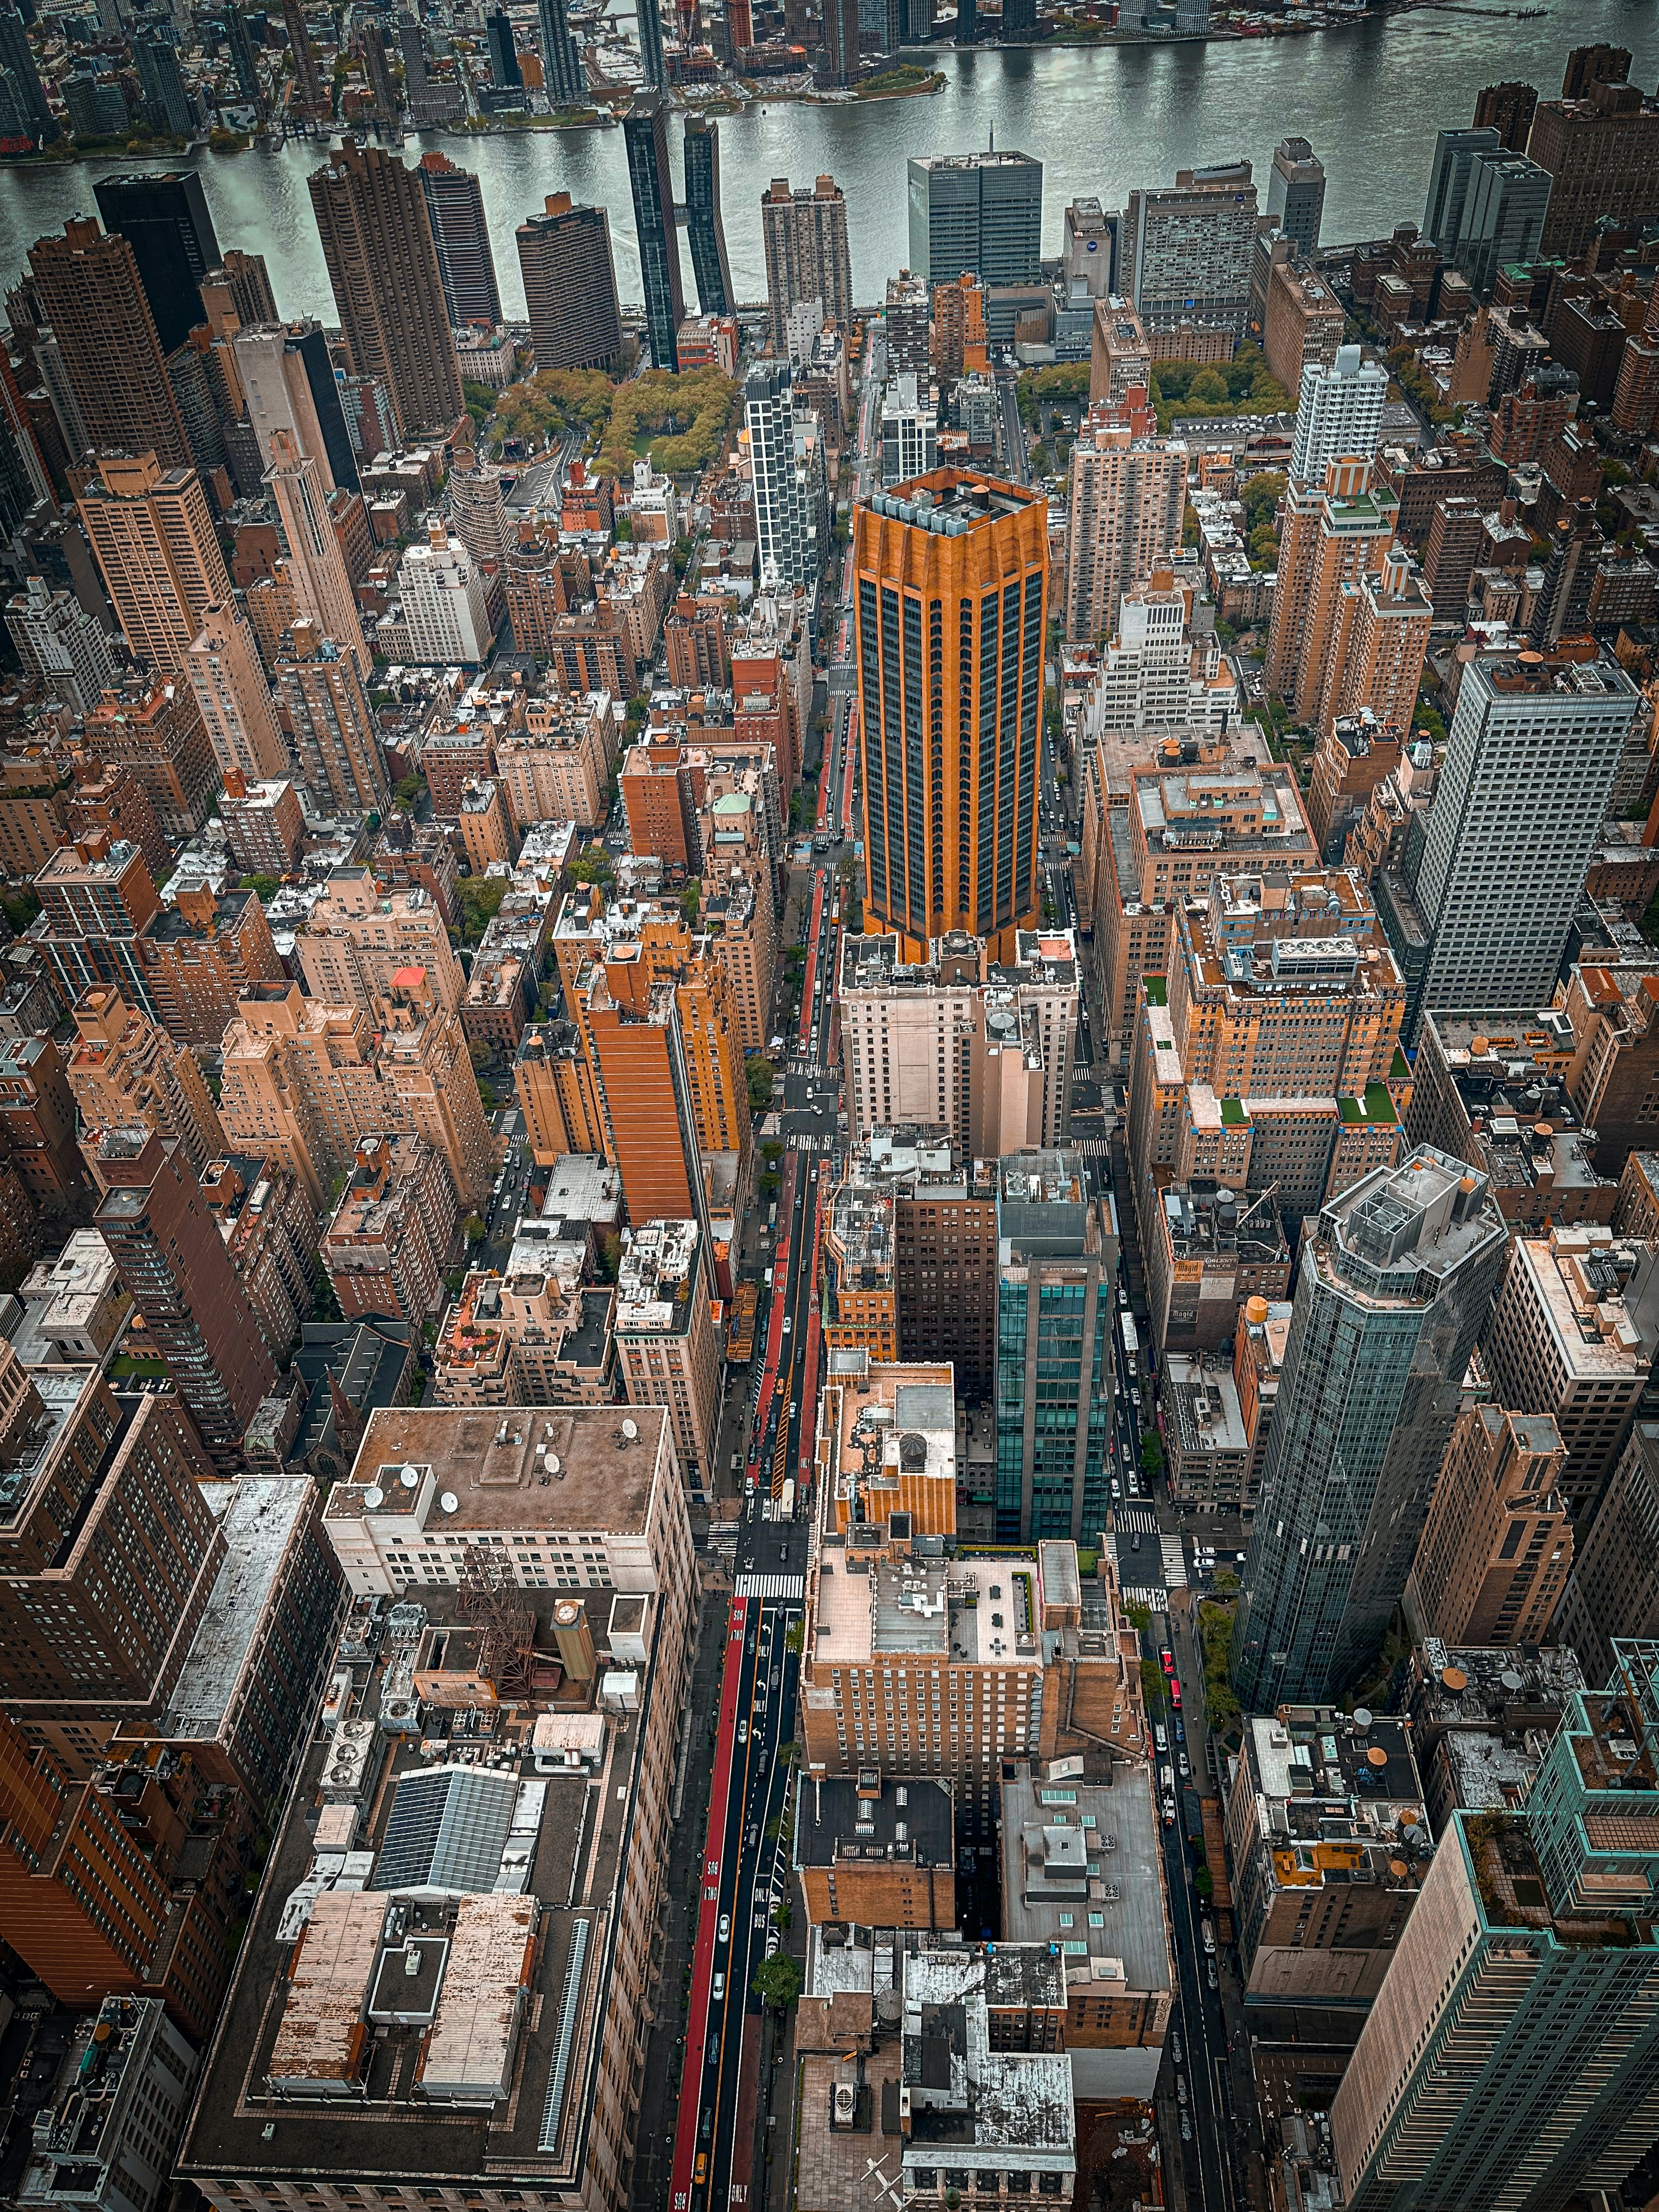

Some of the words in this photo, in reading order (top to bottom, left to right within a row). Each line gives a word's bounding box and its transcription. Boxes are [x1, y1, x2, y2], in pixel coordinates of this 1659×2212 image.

[1178, 1262, 1198, 1274] Magid
[801, 1457, 811, 1469] ONLY
[733, 1610, 743, 1621] BUS
[730, 1630, 743, 1641] ONLY
[758, 1645, 770, 1657] ONLY
[753, 1700, 765, 1713] ONLY
[707, 1861, 719, 1875] BUS
[704, 1886, 717, 1901] ONLY
[755, 1888, 769, 1902] ONLY
[754, 1914, 765, 1928] BUS
[731, 2184, 748, 2202] ONLY
[674, 2192, 686, 2210] BUS
